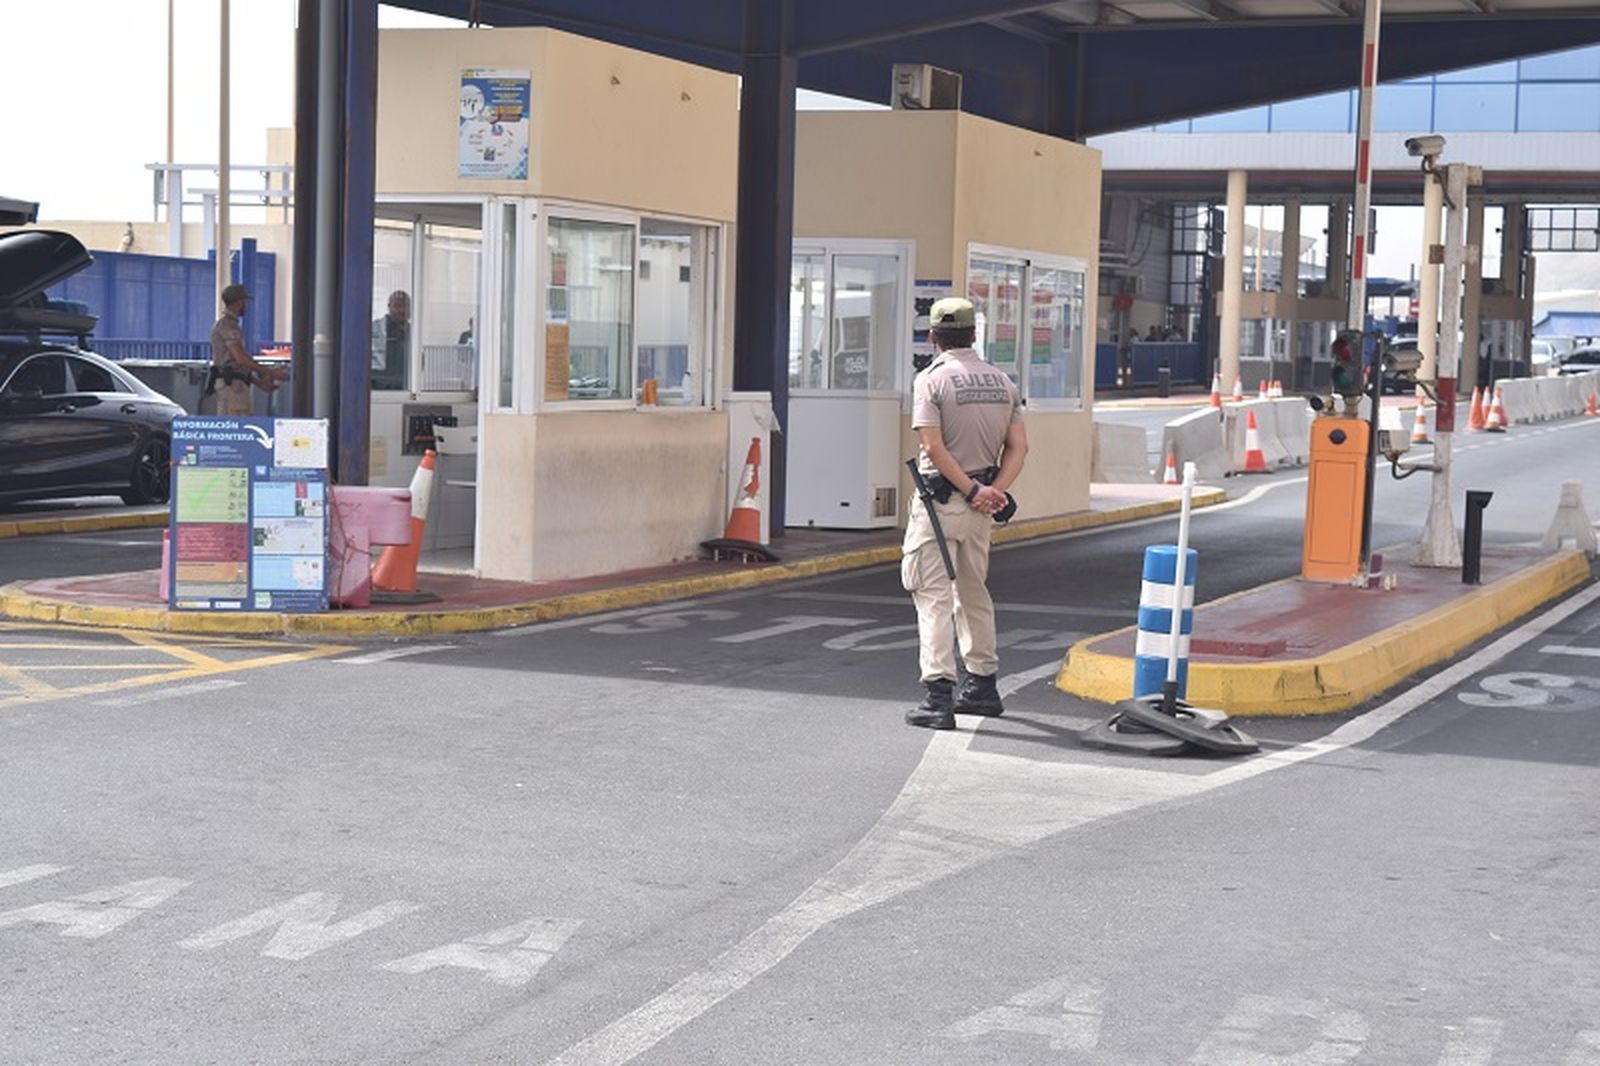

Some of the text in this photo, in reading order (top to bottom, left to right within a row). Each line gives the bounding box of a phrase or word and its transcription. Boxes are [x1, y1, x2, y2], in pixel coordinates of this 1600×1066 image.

[950, 372, 1006, 388] EULEN
[173, 420, 239, 429] INFORMACIÓN
[207, 432, 255, 441] FRONTERA
